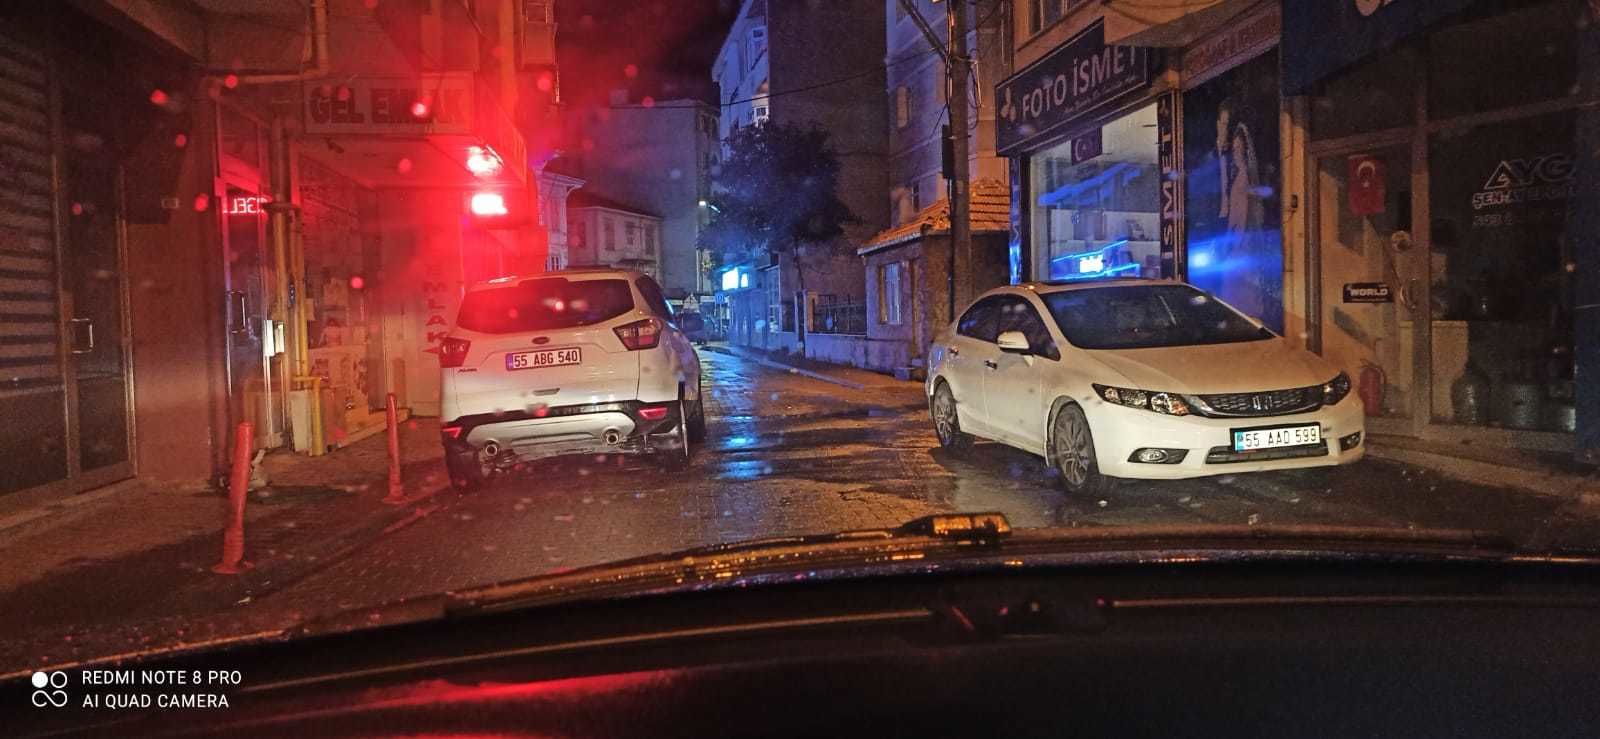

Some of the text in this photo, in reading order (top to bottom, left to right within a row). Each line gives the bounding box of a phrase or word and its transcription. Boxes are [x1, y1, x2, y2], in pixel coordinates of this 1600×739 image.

[311, 86, 364, 124] GEL
[1021, 74, 1066, 120] FOTO
[1483, 153, 1576, 191] AYG
[514, 350, 578, 367] 55 ABG 540
[1245, 432, 1260, 447] 55
[1295, 427, 1316, 442] 599
